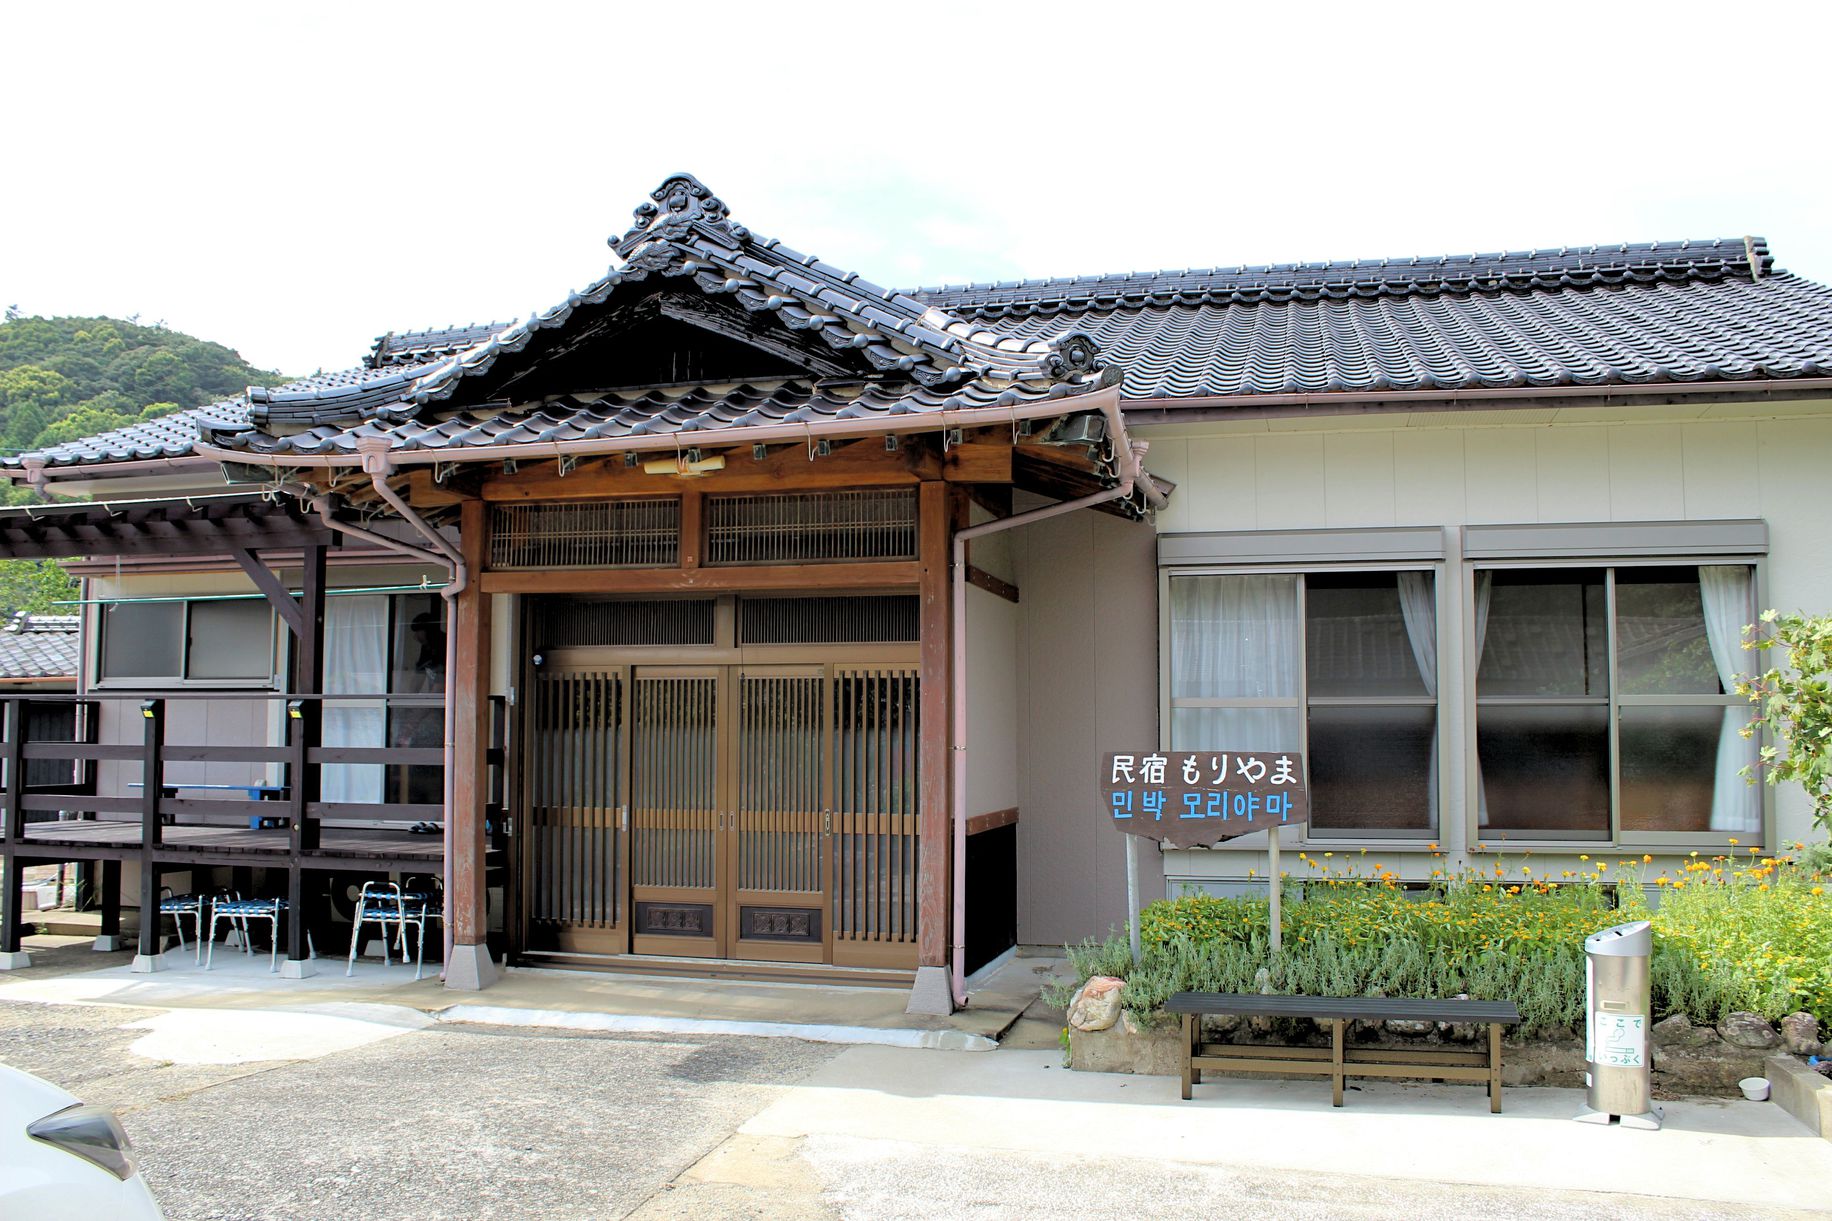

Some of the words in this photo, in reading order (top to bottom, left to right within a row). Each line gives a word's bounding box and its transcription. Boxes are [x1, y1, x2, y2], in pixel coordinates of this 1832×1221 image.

[1112, 753, 1168, 784] 民宿
[1182, 754, 1298, 785] もりやま
[1112, 790, 1167, 821] 민박
[1179, 791, 1293, 822] 모리야마
[1600, 1017, 1642, 1028] ここで
[1599, 1054, 1640, 1064] いっぷく
